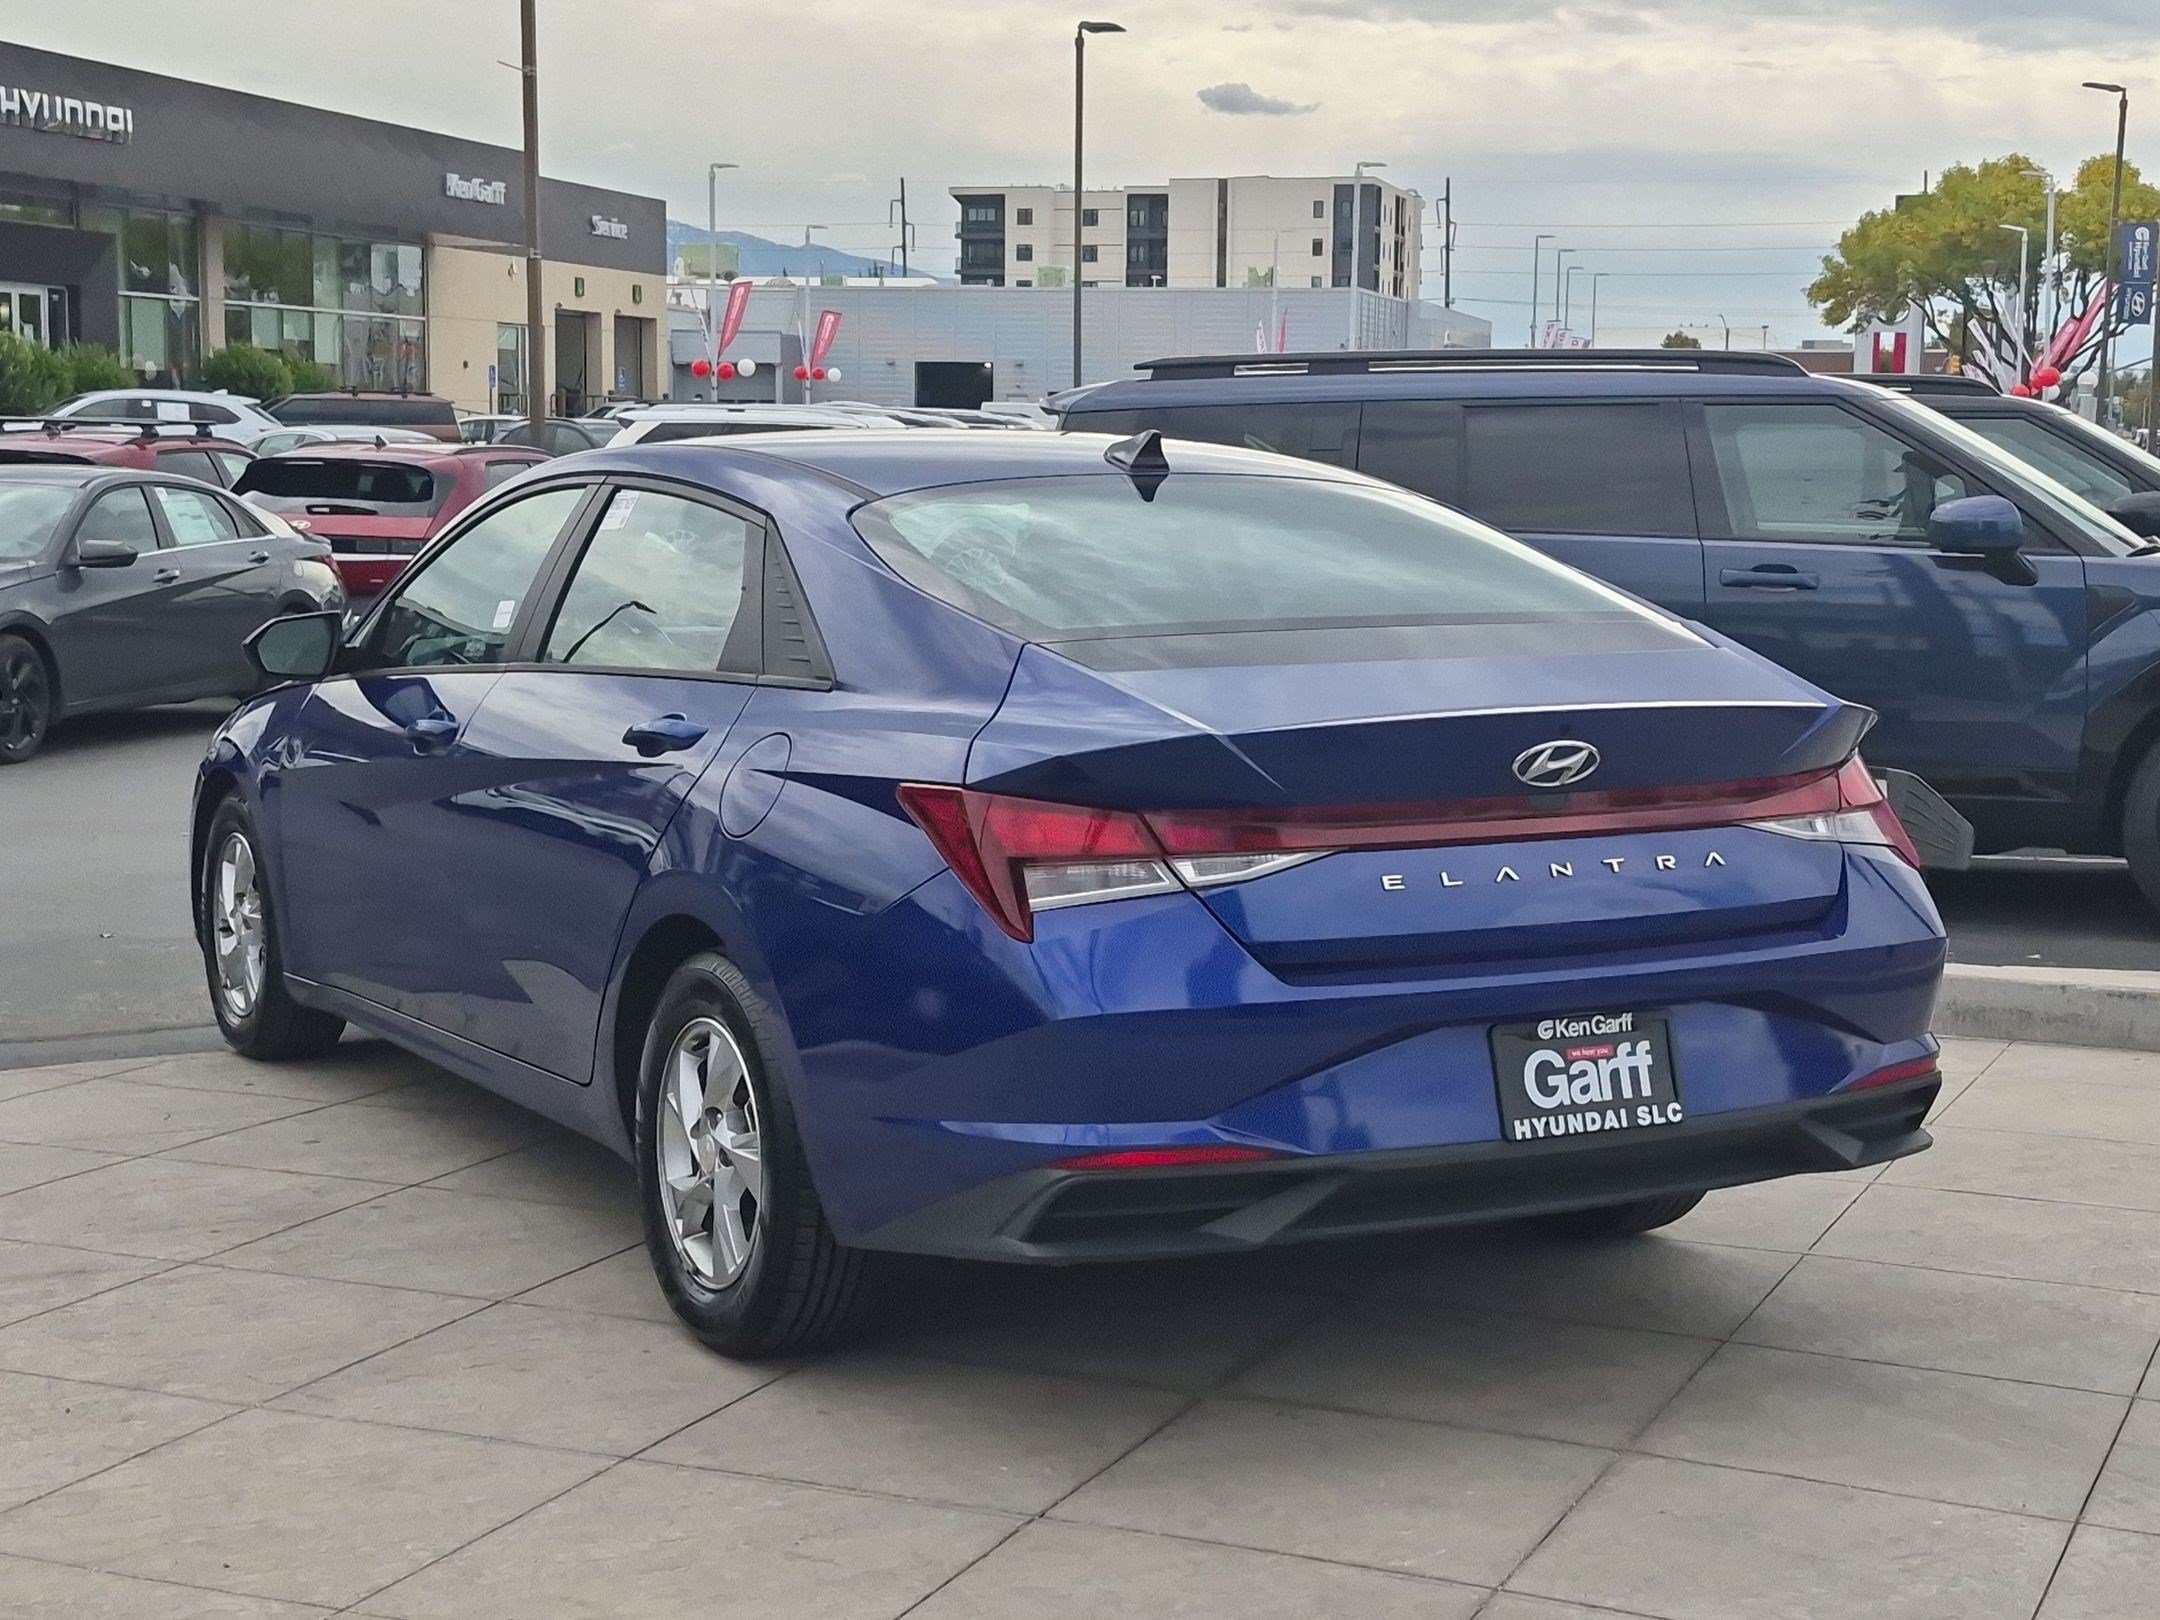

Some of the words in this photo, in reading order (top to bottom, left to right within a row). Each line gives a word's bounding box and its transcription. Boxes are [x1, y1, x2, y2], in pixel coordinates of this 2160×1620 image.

[0, 85, 134, 134] HYUNDAI
[592, 215, 628, 240] Service
[1381, 851, 1727, 891] ELANTRA
[1555, 1018, 1590, 1039] Ken
[1591, 1012, 1633, 1035] Garff
[1523, 1040, 1653, 1109] Garff
[1513, 1108, 1628, 1141] HYUNDAI
[1636, 1102, 1683, 1127] SLC
